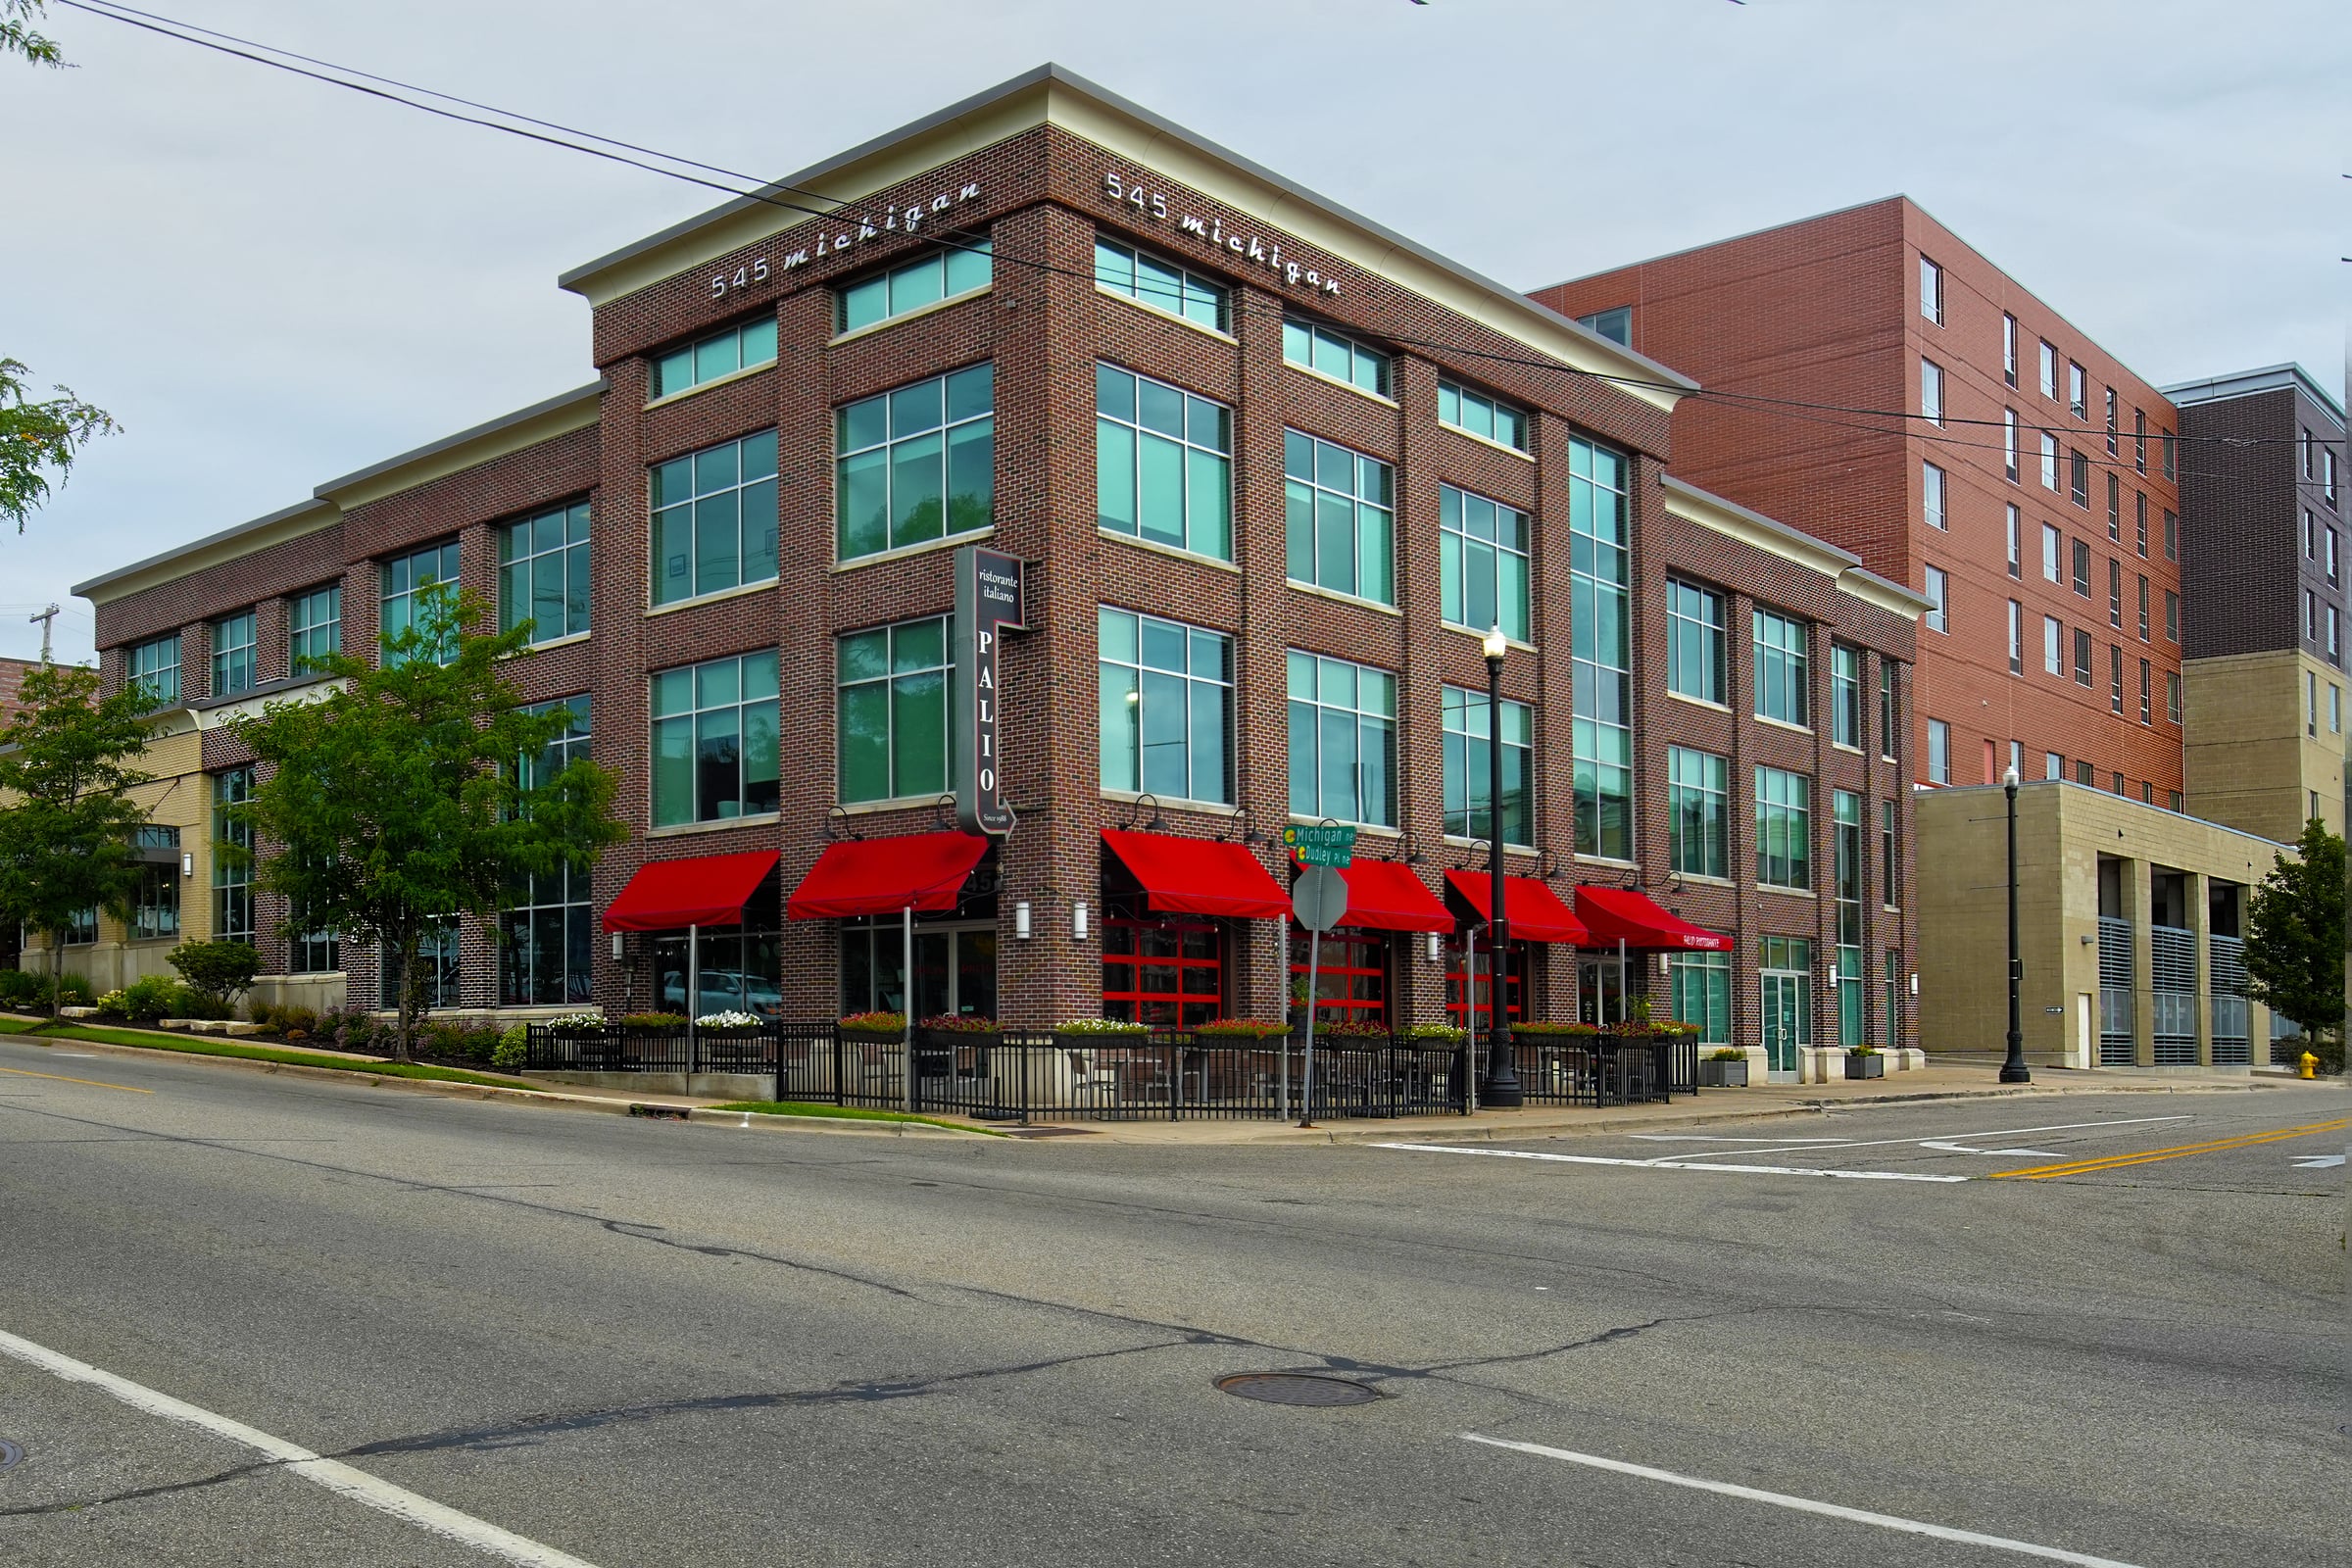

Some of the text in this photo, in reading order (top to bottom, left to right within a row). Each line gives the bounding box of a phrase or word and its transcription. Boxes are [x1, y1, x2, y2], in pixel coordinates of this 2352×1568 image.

[711, 183, 980, 298] 545 michigan
[1105, 172, 1341, 294] 545 michigan
[979, 568, 1018, 588] ristorante
[983, 585, 1014, 603] italiano
[978, 630, 995, 791] PALIO
[1297, 827, 1343, 846] Michigan
[1305, 845, 1331, 865] Dudley
